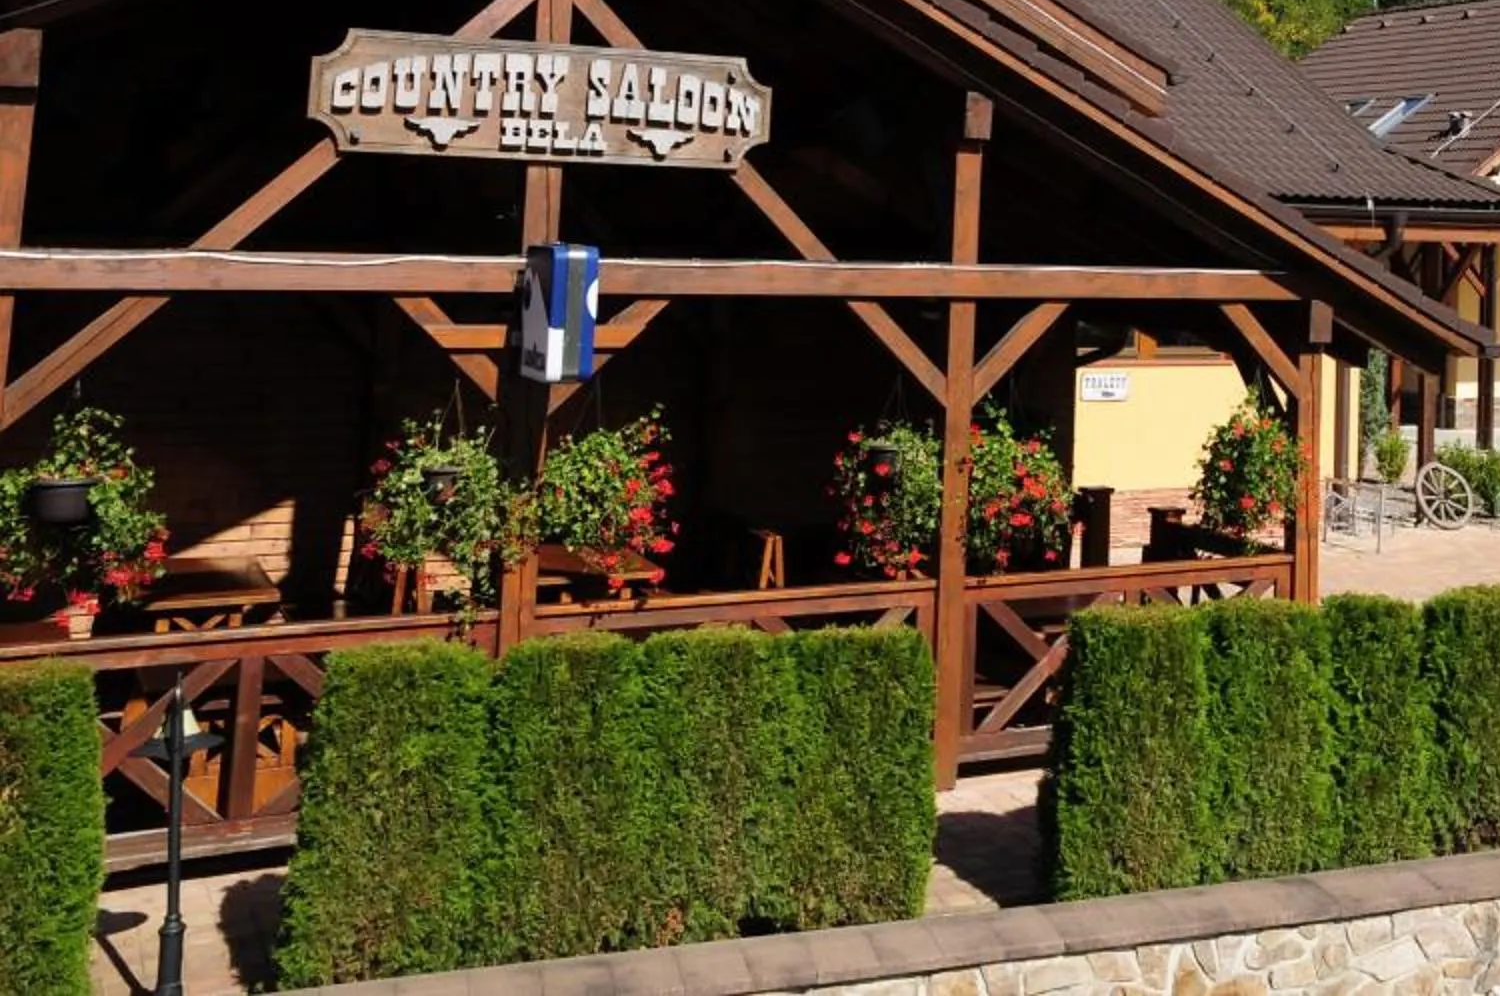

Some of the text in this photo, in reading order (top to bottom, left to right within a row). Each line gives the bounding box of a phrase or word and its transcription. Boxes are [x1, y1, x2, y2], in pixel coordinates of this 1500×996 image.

[331, 53, 761, 137] COUNTRY SALOON
[500, 118, 607, 152] BELA
